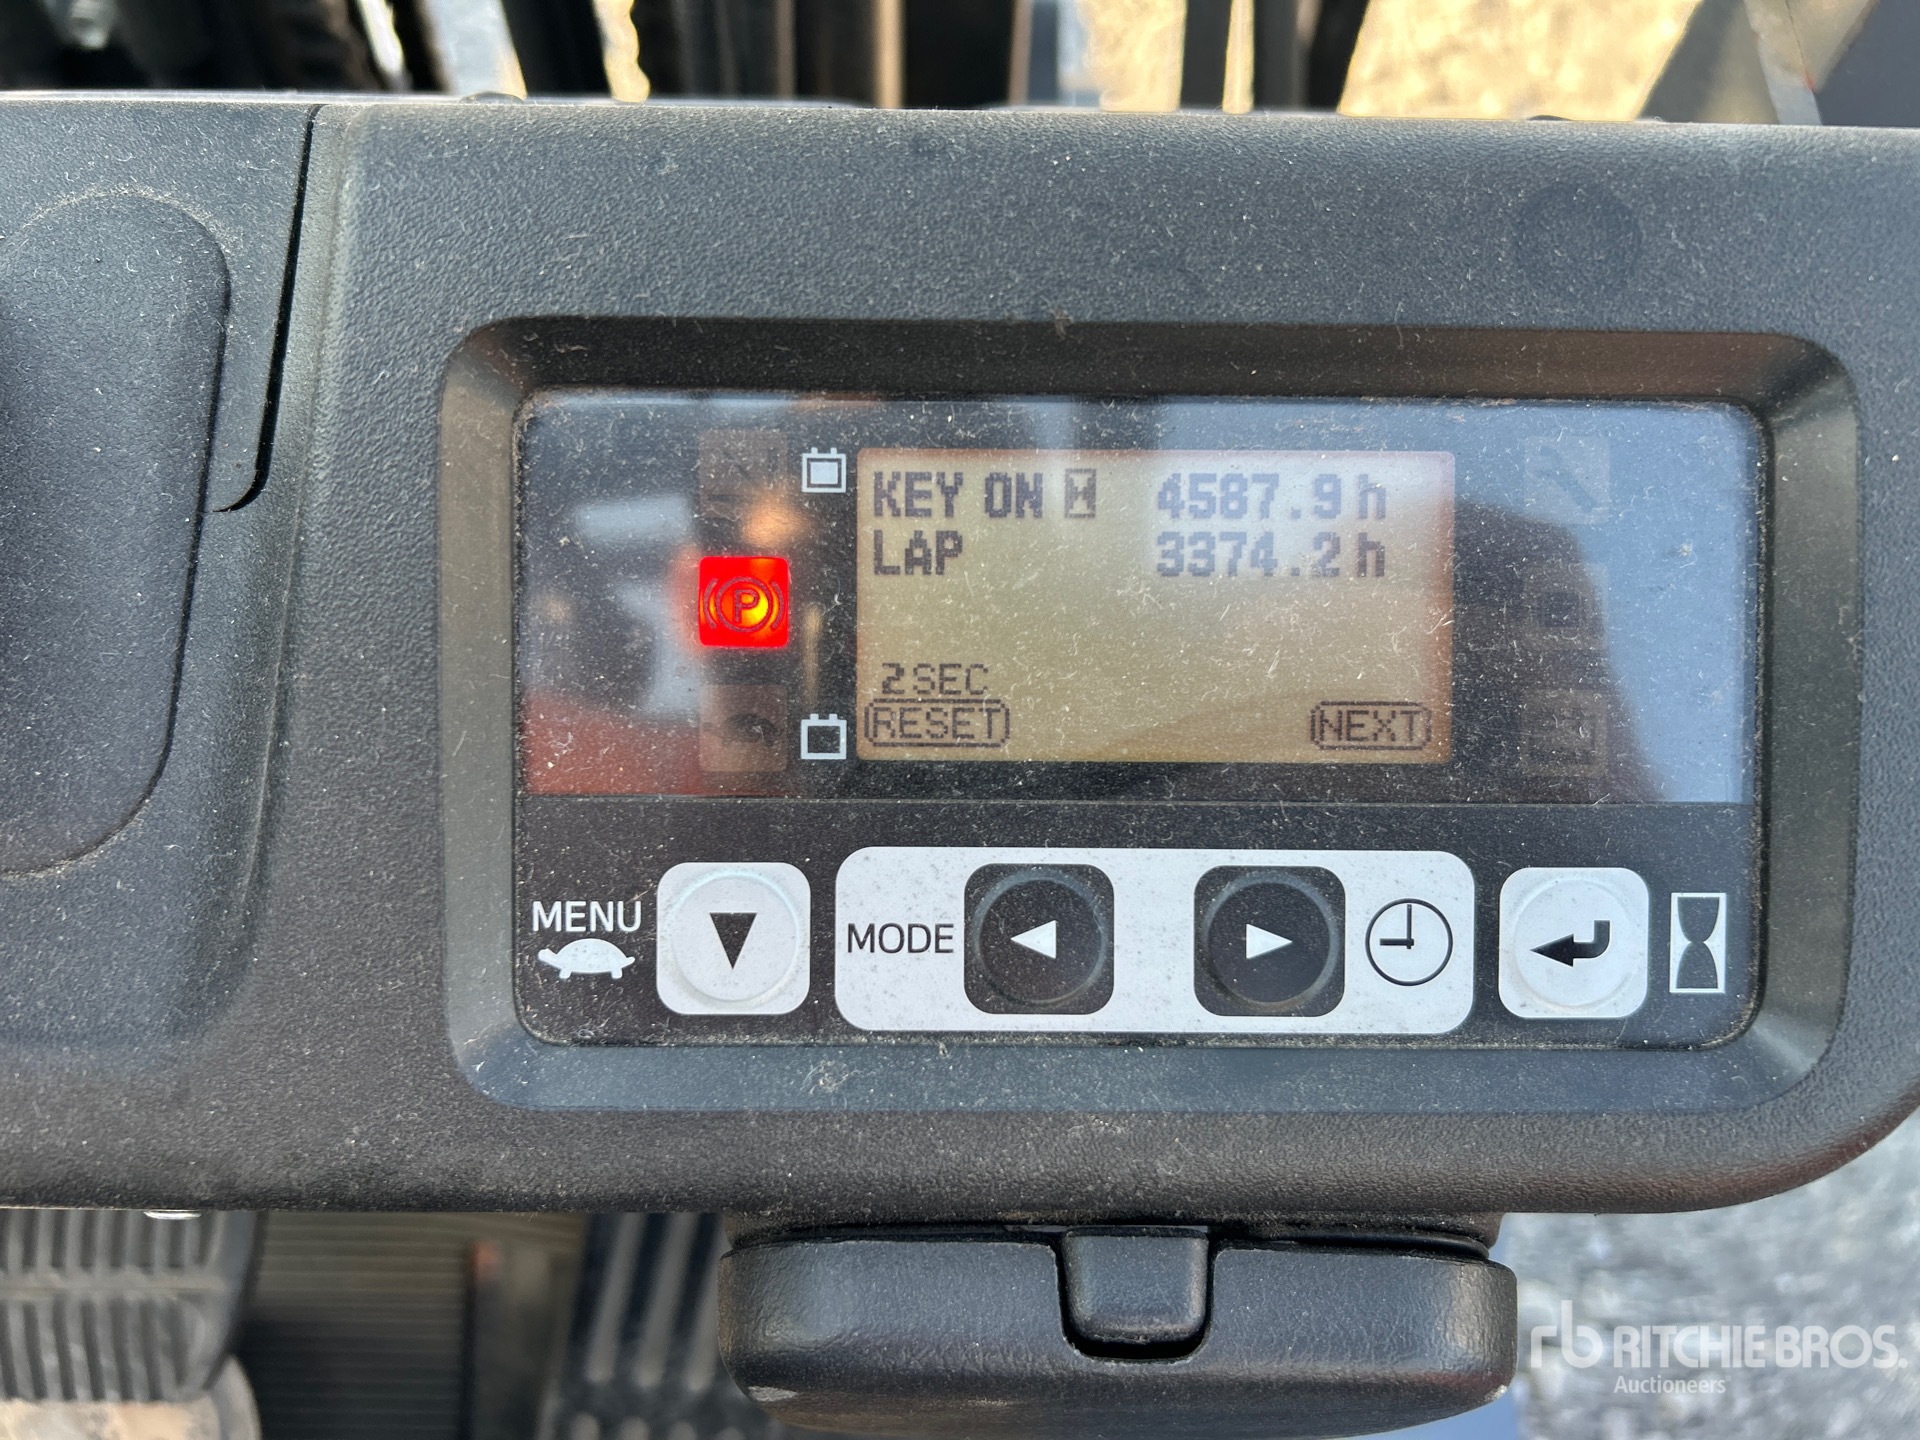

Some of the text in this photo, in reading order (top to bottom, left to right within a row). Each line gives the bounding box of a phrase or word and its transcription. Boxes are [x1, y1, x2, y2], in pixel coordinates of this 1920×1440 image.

[872, 472, 1386, 519] KEY ON 4587.9 h
[873, 530, 1385, 577] LAP 3374.2 h
[872, 708, 1000, 739] RESET
[1319, 710, 1420, 741] NEXT
[531, 900, 642, 933] MENU
[847, 923, 955, 954] MODE
